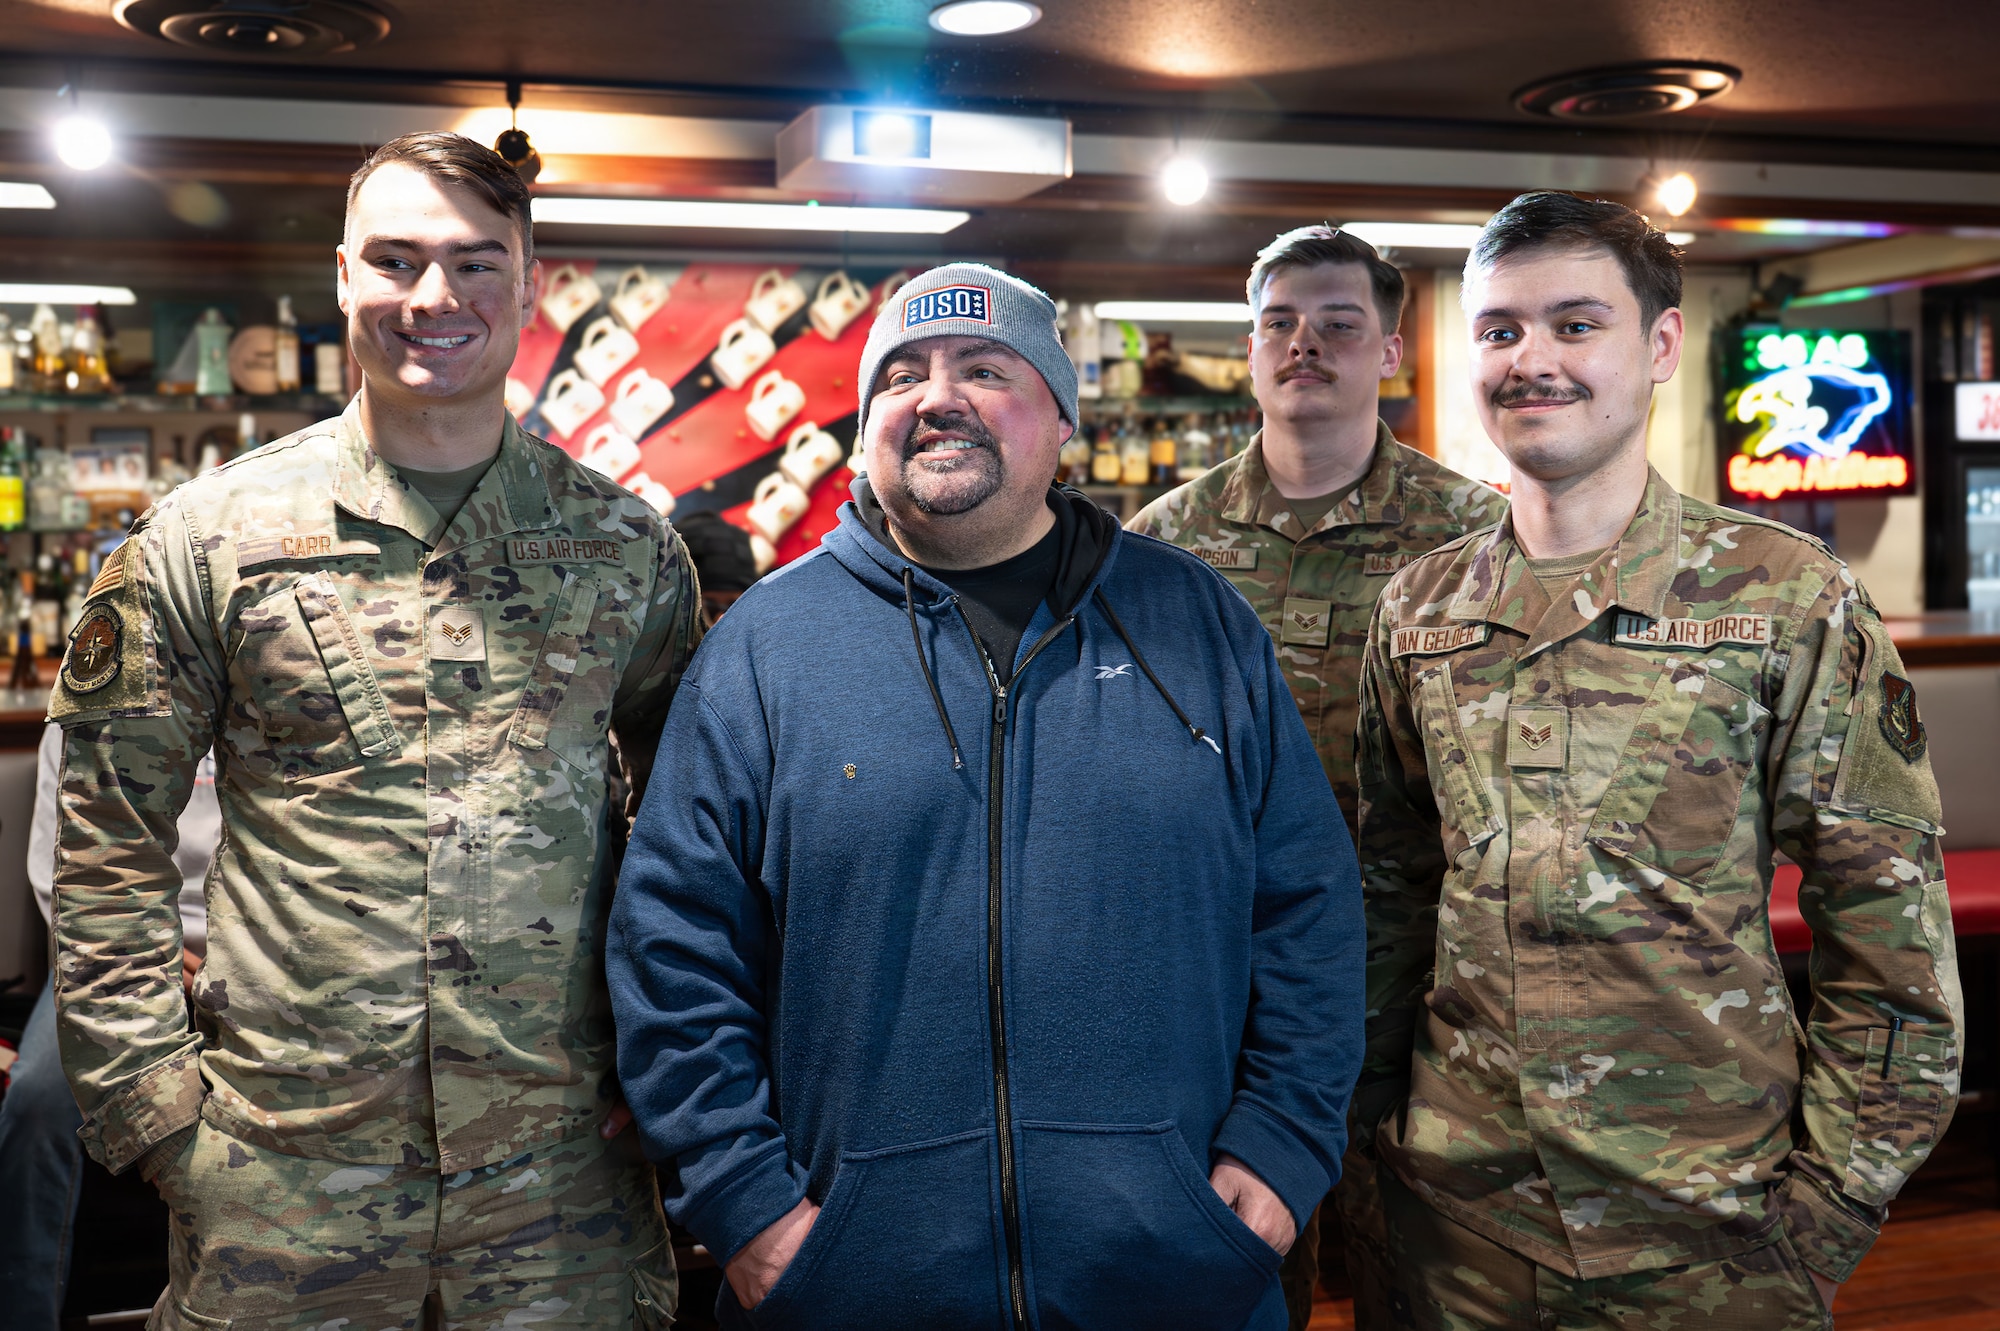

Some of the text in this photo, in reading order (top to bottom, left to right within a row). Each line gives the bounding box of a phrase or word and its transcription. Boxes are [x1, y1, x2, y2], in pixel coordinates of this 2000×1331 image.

[920, 290, 971, 320] USO
[281, 535, 332, 557] CARR
[514, 540, 621, 561] U.S. AIR FORCE
[1371, 555, 1394, 571] U.S.
[1397, 625, 1476, 653] VAN GELDER
[1627, 617, 1766, 646] U.S. AIR FORCE
